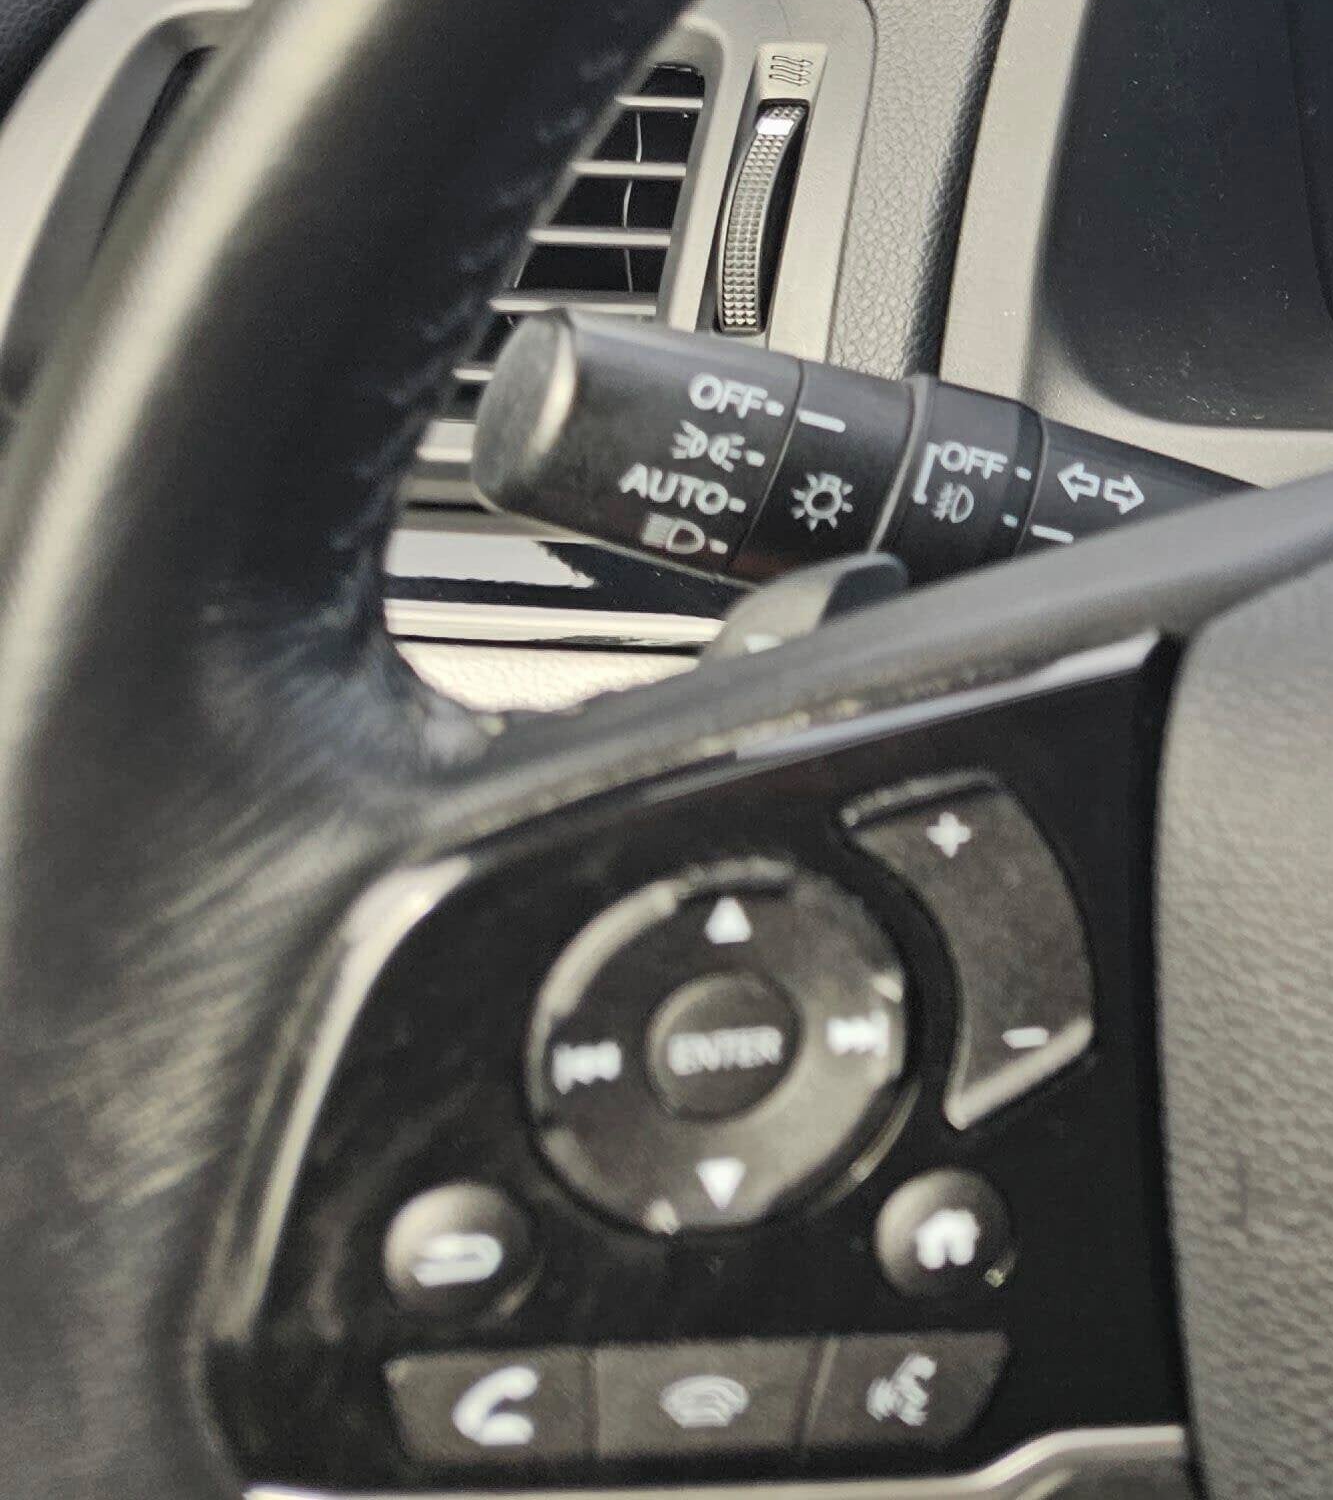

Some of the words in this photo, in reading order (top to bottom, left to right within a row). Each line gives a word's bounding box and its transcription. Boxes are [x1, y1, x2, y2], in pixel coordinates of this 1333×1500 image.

[688, 372, 768, 418] OFF
[938, 440, 1009, 480] OFF
[618, 462, 730, 516] AUTO
[667, 1025, 783, 1077] ENTER
